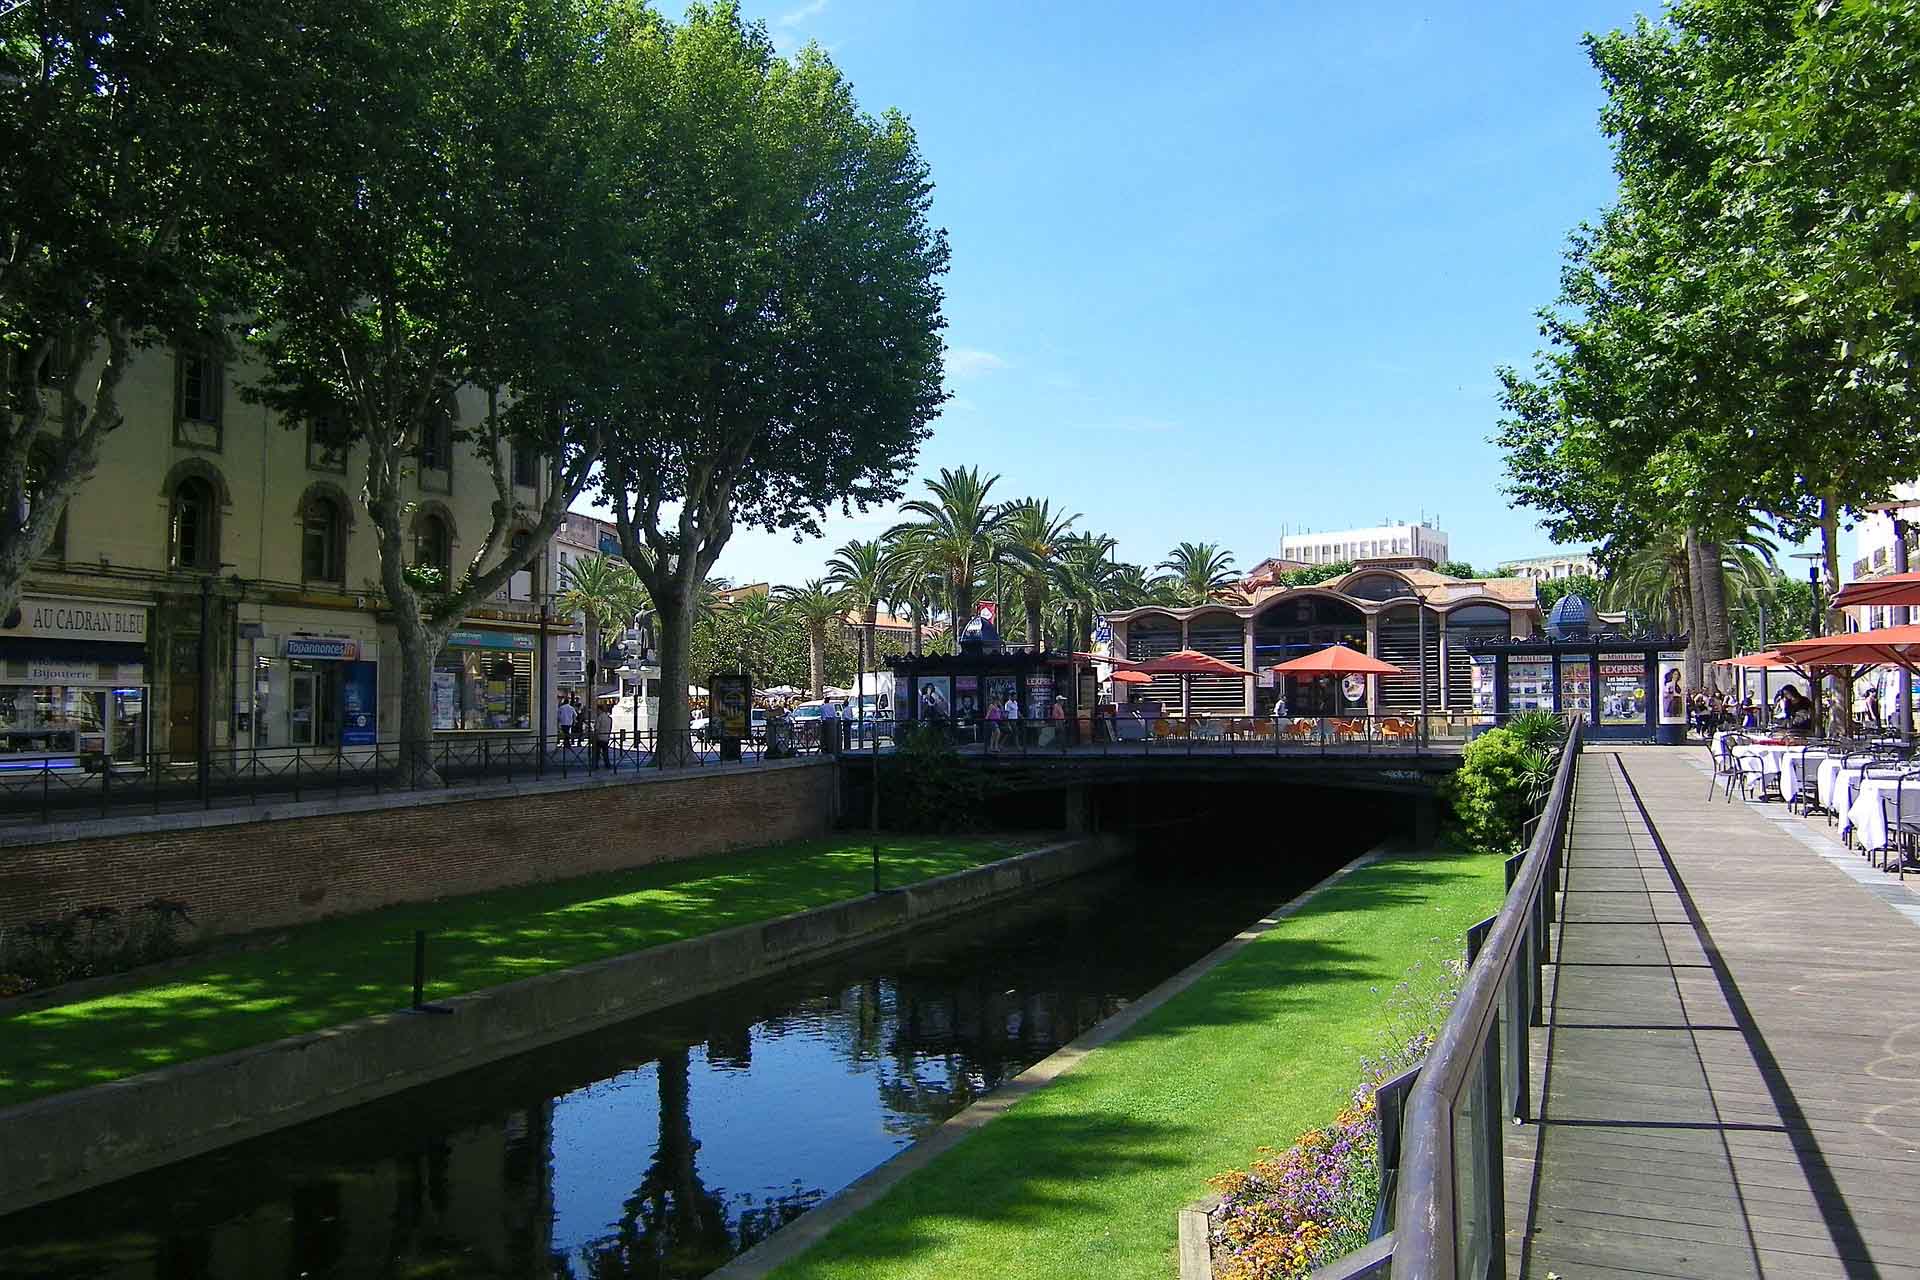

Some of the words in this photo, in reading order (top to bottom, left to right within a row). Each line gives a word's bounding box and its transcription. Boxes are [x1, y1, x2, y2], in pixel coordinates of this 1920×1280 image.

[33, 607, 53, 629] AU
[56, 608, 112, 633] CADRAN
[115, 613, 144, 634] BLEU
[33, 668, 91, 681] Bijouterie
[1599, 664, 1645, 674] L'EXPRESS
